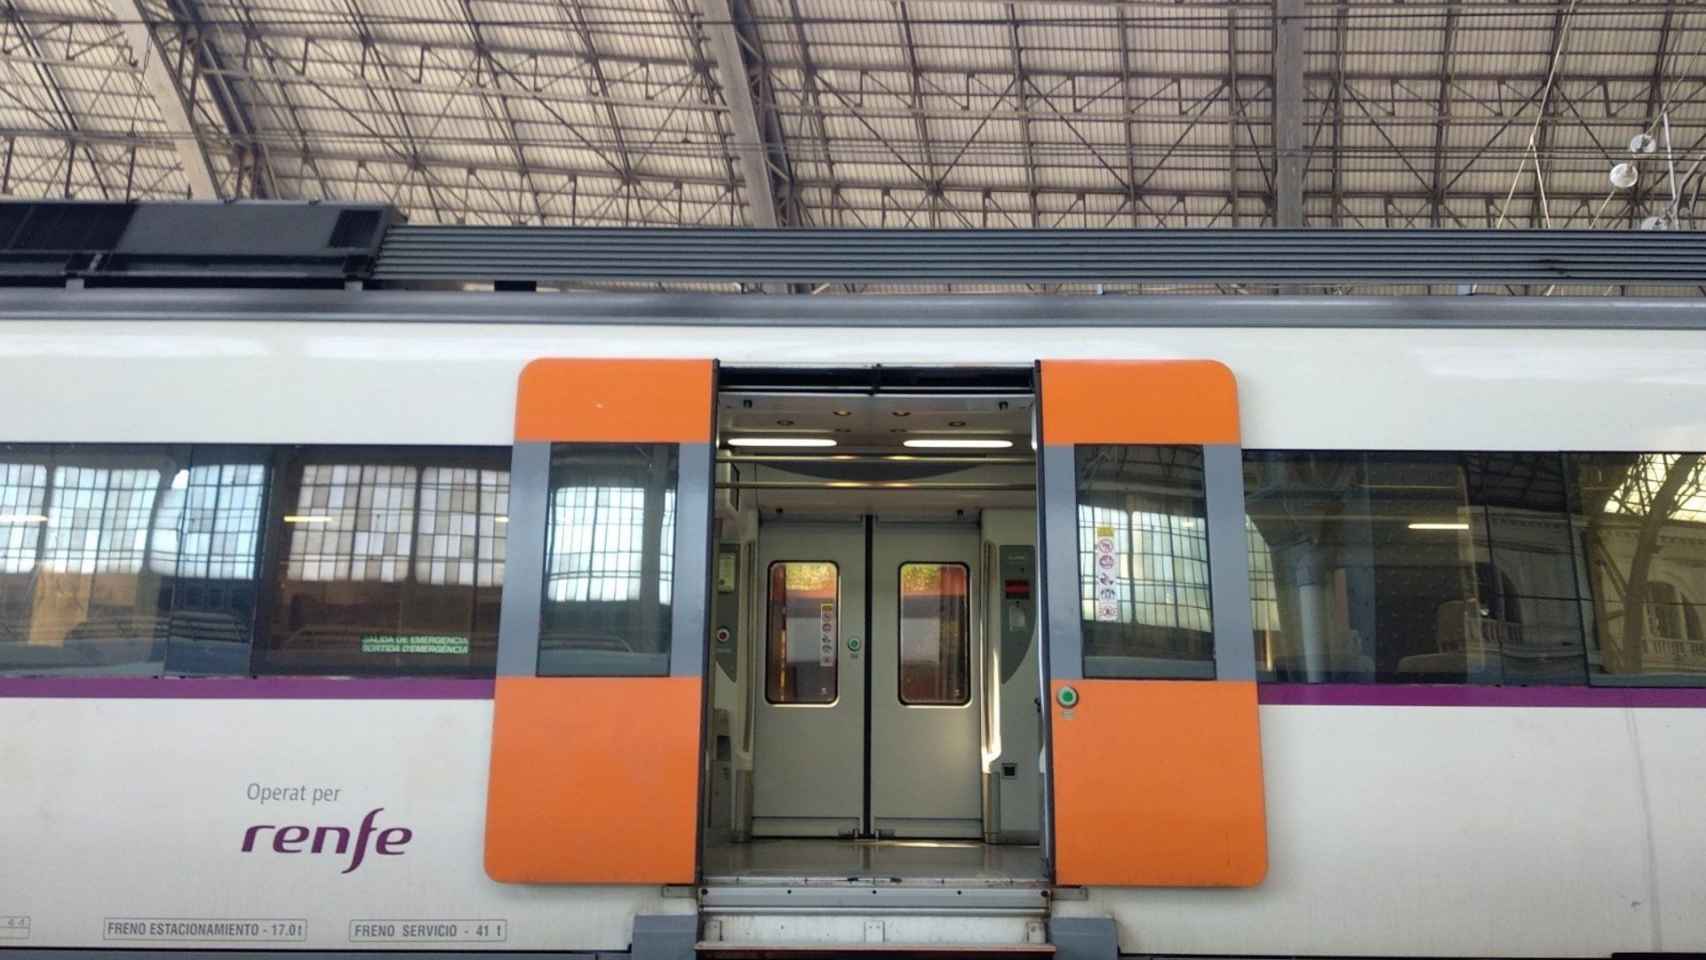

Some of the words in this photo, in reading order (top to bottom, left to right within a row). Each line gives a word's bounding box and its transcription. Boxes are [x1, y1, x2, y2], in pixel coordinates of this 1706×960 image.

[246, 783, 306, 805] Operat
[311, 786, 342, 806] per
[240, 807, 413, 875] renfe
[108, 922, 146, 935] FRENO
[150, 923, 259, 936] ESTACIONAMIENTO
[354, 924, 395, 937] FRENO
[402, 924, 457, 937] SERVICIO
[475, 925, 489, 937] 41
